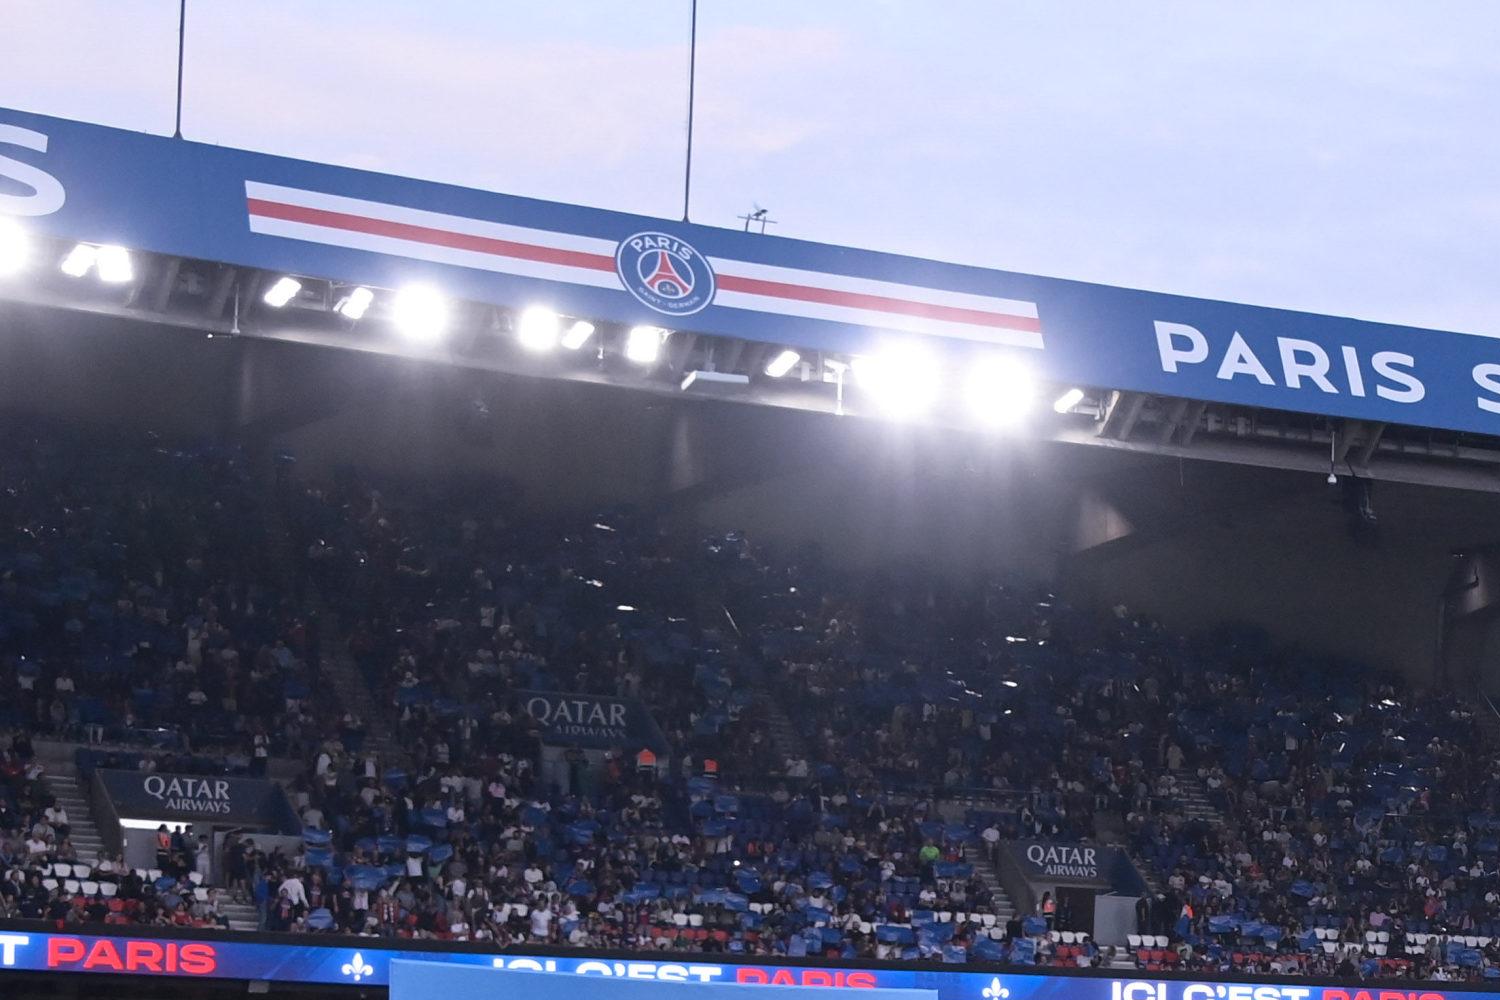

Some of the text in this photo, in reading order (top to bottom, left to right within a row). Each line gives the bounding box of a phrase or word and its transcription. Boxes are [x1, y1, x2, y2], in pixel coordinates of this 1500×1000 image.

[630, 236, 693, 260] PARIS
[1153, 320, 1425, 403] PARIS
[527, 697, 626, 726] QATAR
[144, 776, 230, 800] QATAR
[165, 798, 231, 814] AIRWAYS
[1027, 845, 1096, 866] QATAR
[1044, 864, 1097, 877] AIRWAYS
[47, 937, 216, 974] PARIS
